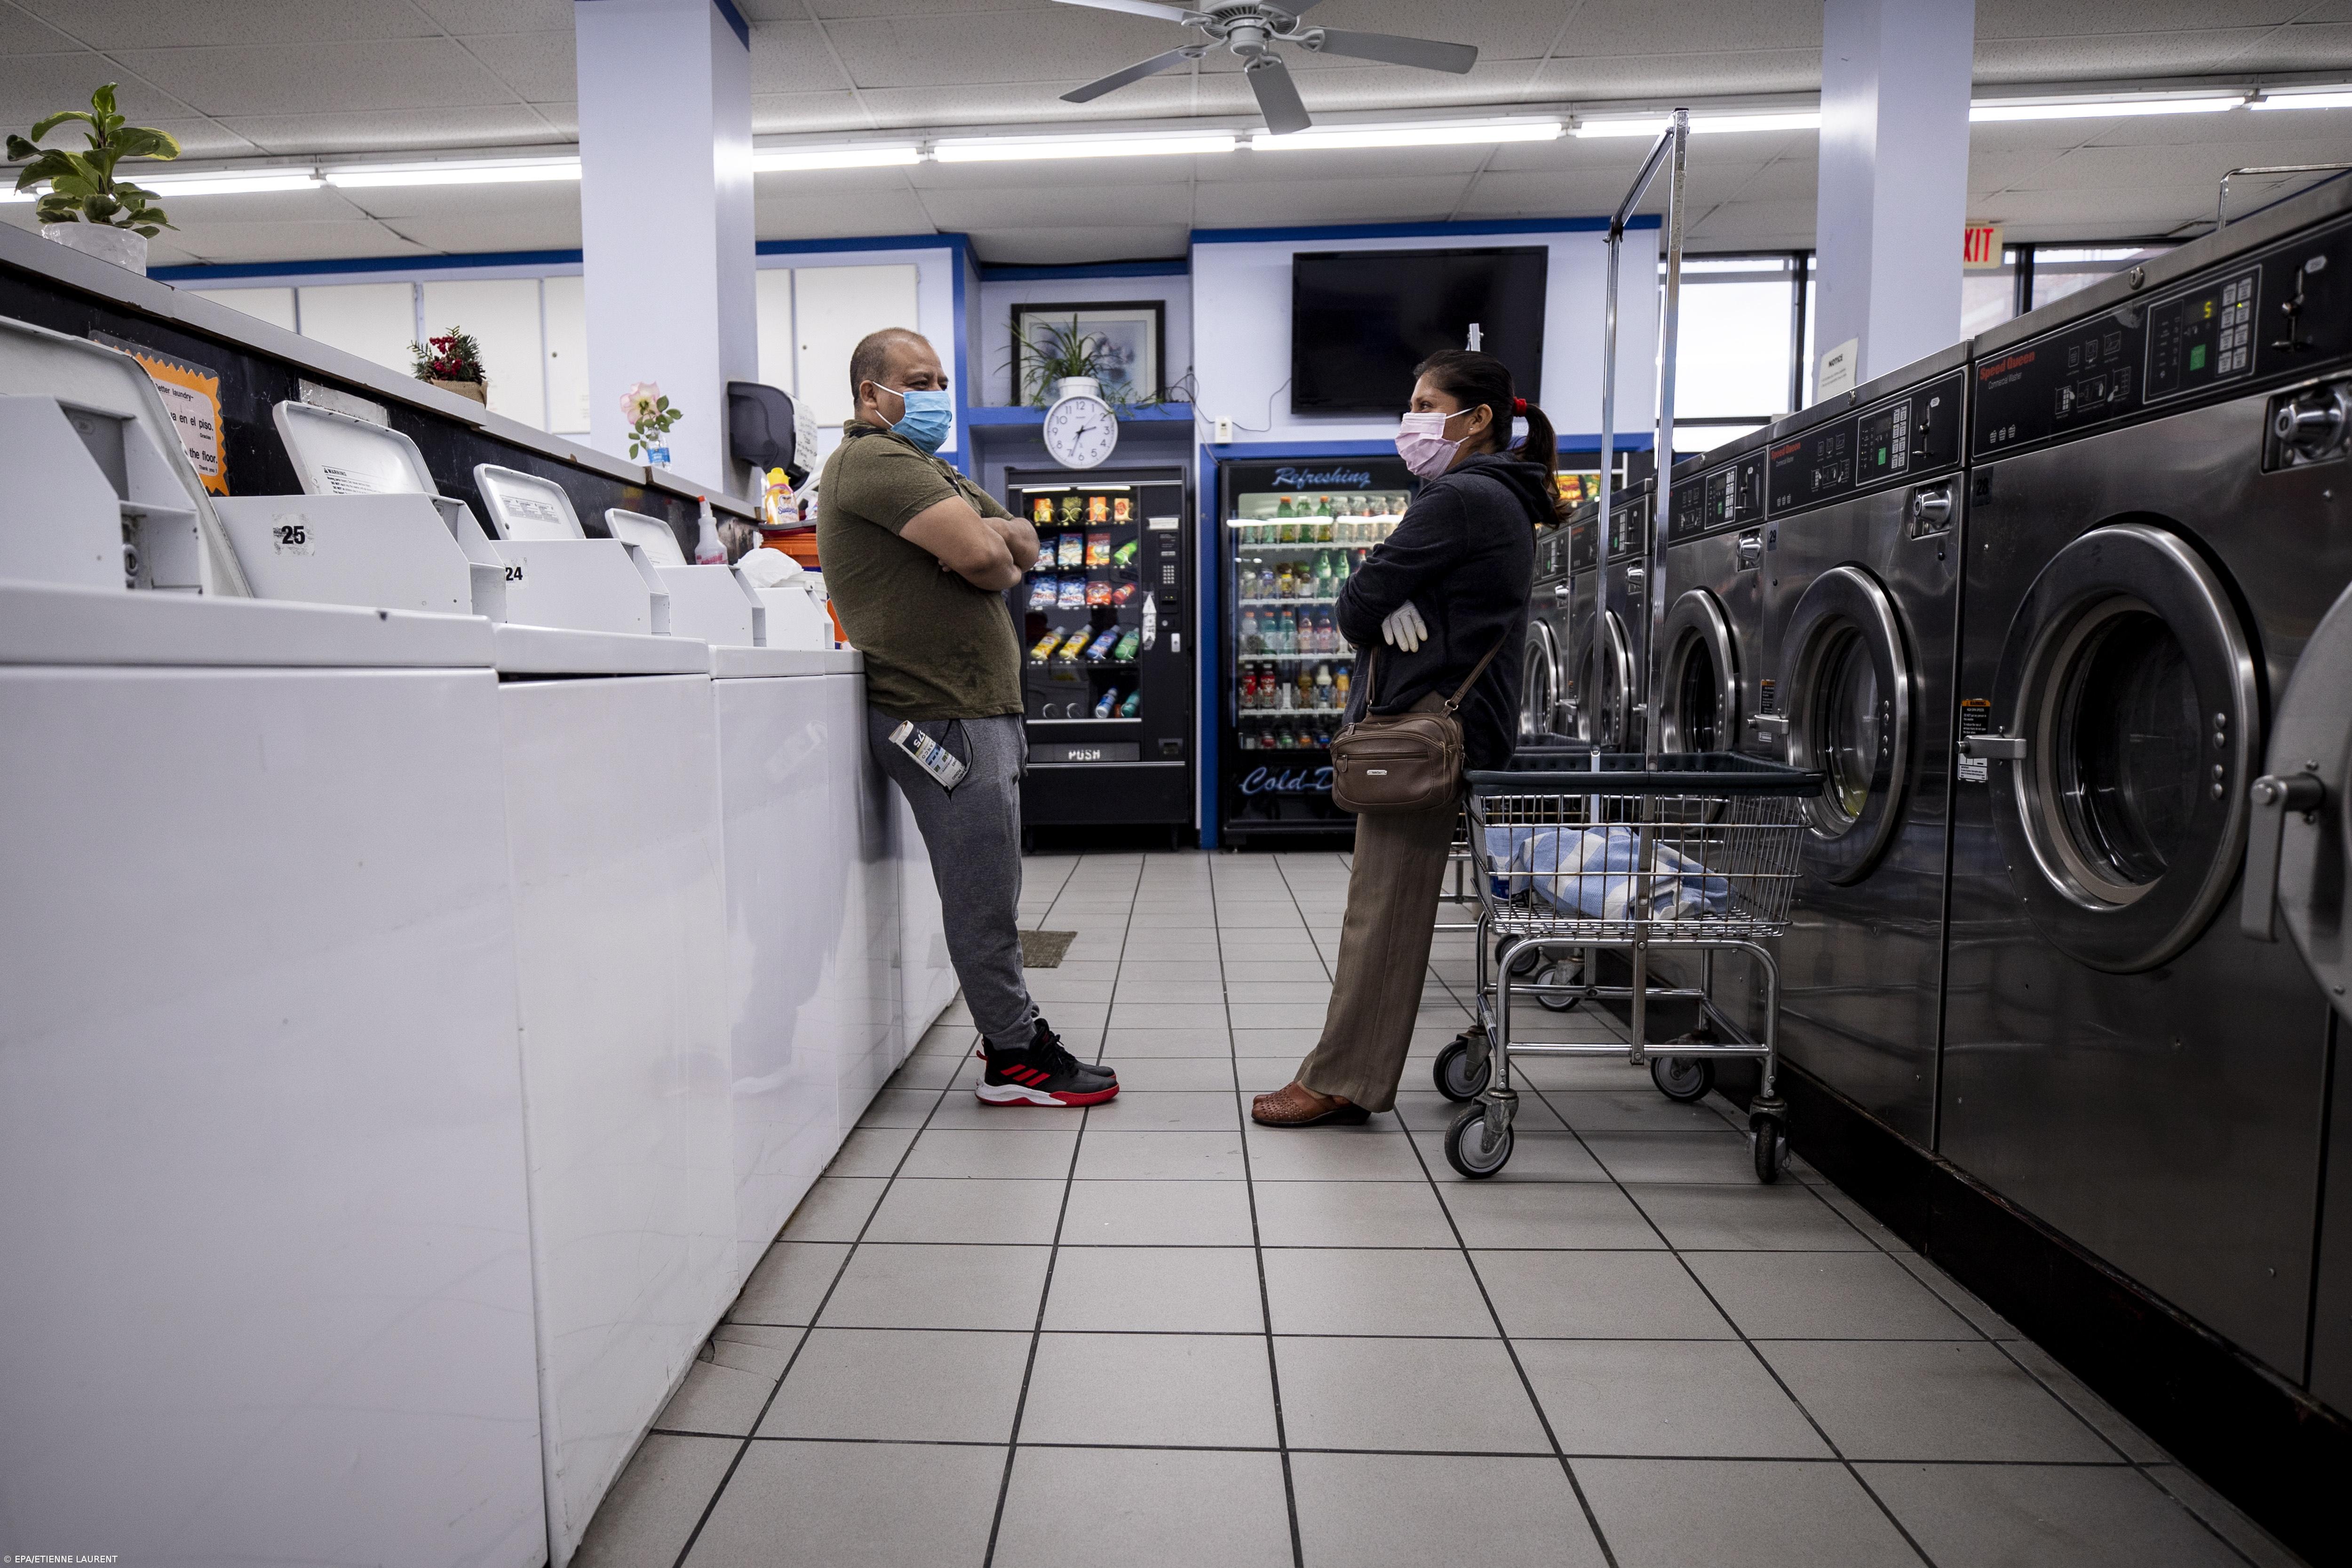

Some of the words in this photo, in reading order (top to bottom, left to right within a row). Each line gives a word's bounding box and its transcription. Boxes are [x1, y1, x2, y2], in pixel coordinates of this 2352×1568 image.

[1828, 353, 1843, 367] NOTICE
[1980, 359, 2006, 381] Speed
[2007, 351, 2035, 369] Queen
[1988, 375, 2008, 390] Commercial
[1076, 401, 1085, 410] 12
[180, 415, 188, 424] en
[191, 416, 196, 426] el
[199, 419, 214, 431] piso.
[1056, 416, 1067, 424] 10
[1104, 426, 1110, 435] 3
[190, 448, 199, 459] the
[202, 451, 218, 464] floor.
[1078, 452, 1084, 461] 6
[1771, 446, 1785, 461] Speed
[1786, 442, 1801, 454] Queen
[1271, 467, 1371, 490] Refreshing
[1976, 477, 1989, 496] 28
[282, 525, 305, 544] 25
[1770, 530, 1777, 543] 29
[506, 566, 523, 581] 24
[1069, 749, 1100, 760] PUSH
[1238, 766, 1307, 796] Cold
